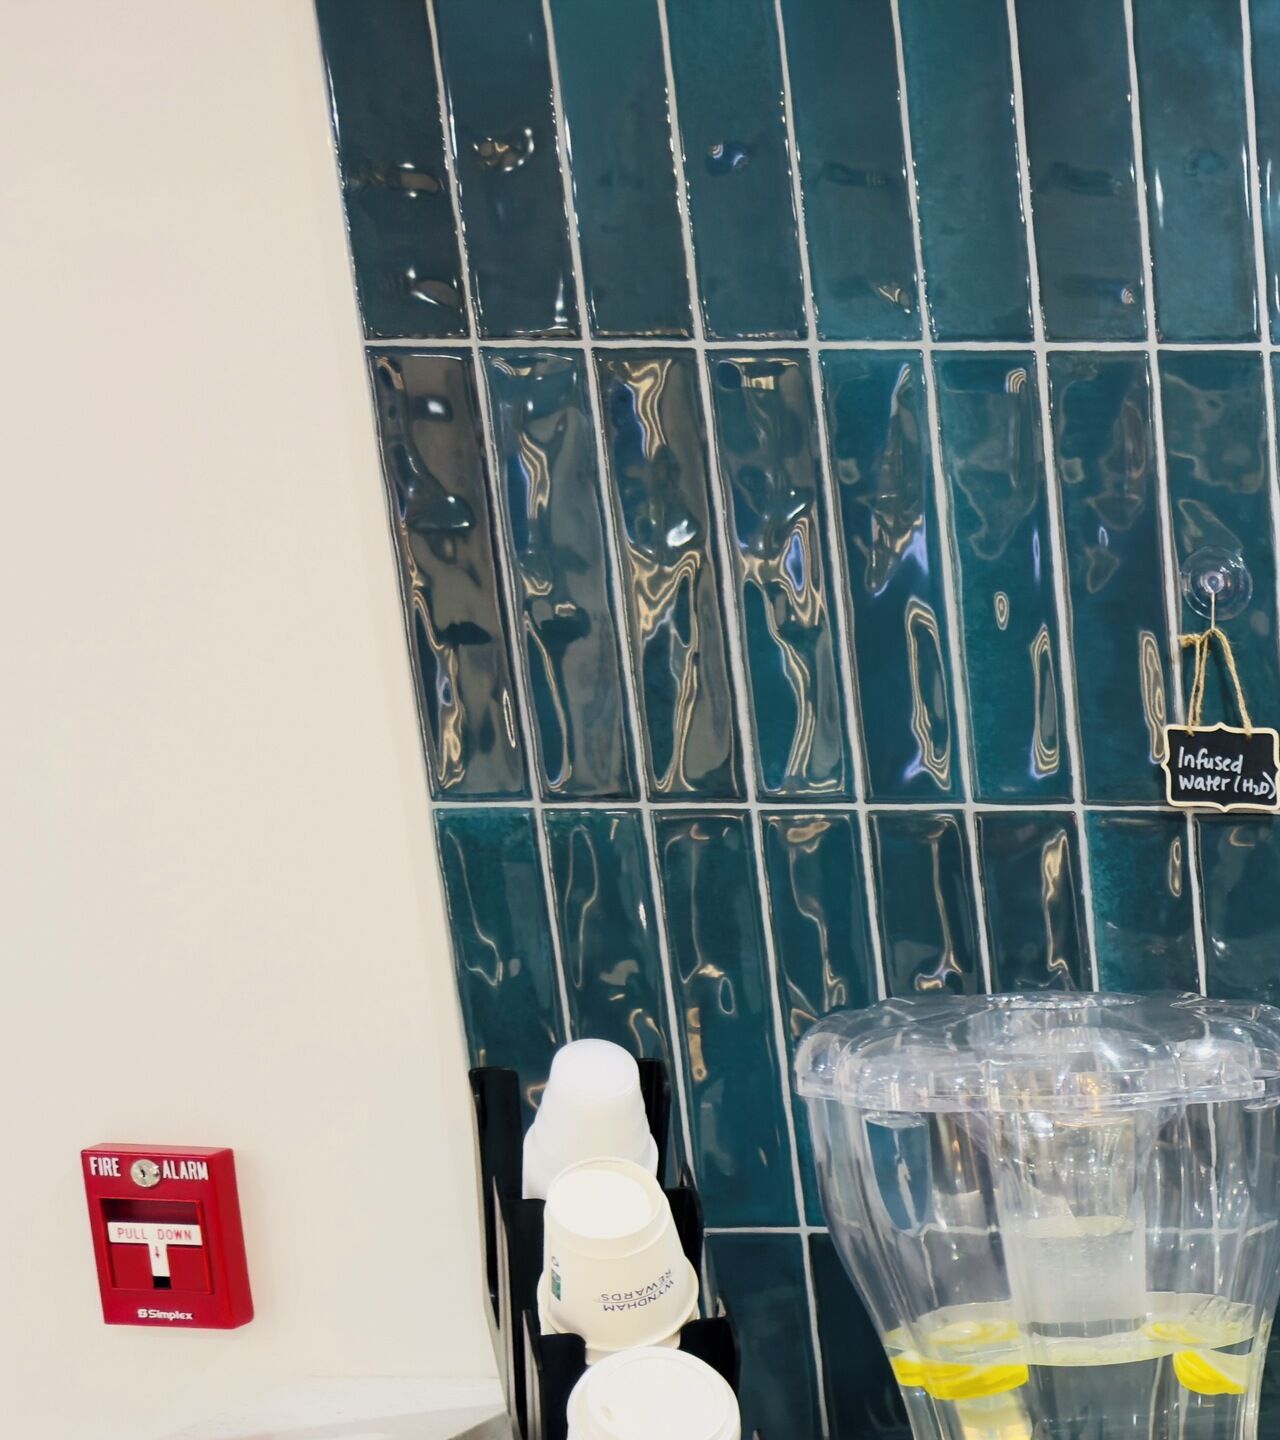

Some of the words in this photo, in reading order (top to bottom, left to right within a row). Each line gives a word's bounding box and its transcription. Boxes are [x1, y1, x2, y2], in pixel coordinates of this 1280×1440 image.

[1177, 745, 1244, 774] Infused
[89, 1157, 121, 1177] FIRE
[162, 1160, 209, 1181] ALARM
[117, 1227, 149, 1240] PULL
[157, 1228, 193, 1241] DOWN
[602, 1279, 675, 1312] WYNDHAM
[148, 1310, 194, 1321] Simplex
